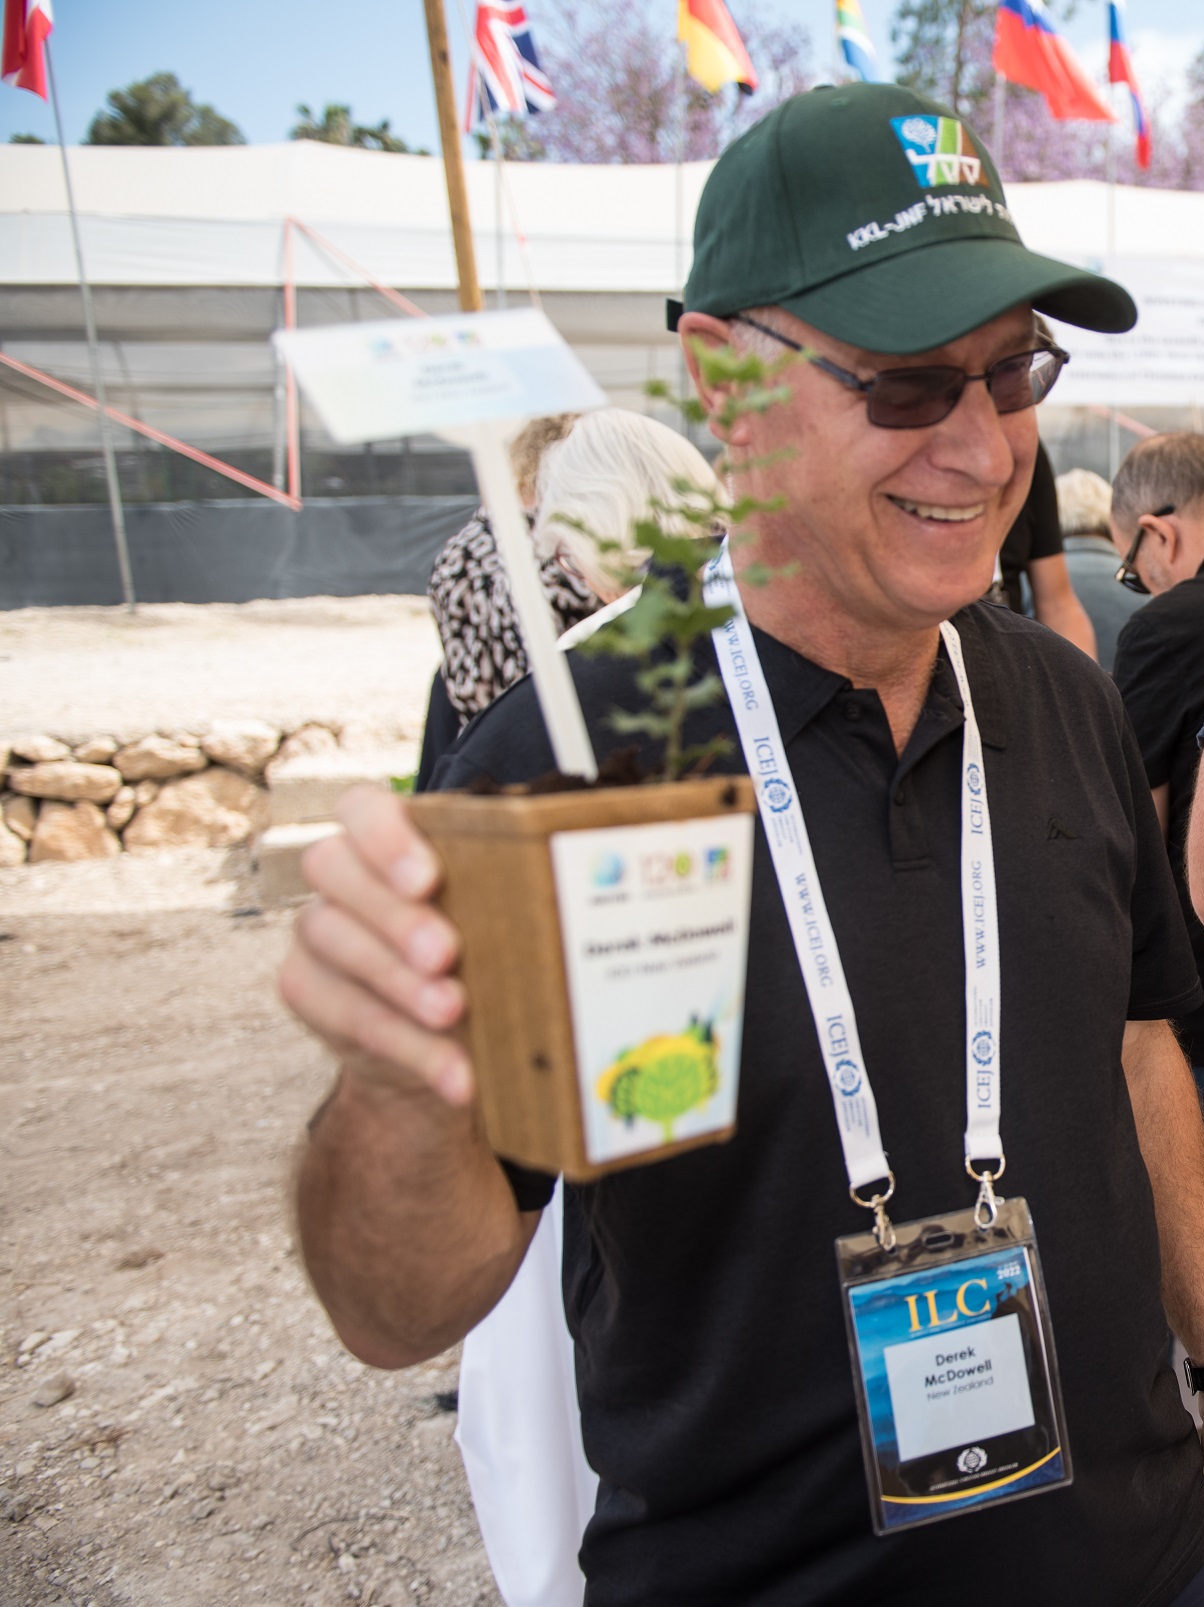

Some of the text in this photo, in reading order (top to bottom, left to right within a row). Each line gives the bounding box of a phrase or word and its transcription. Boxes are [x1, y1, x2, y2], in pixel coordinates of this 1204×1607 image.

[846, 202, 927, 250] KKL-JNF
[724, 618, 758, 711] WW.ICEJ.ORG
[753, 736, 779, 777] ICEJ
[971, 798, 985, 835] ICEJ
[795, 872, 834, 988] WWW.ICEJ.ORG
[976, 860, 986, 970] WWW.ICEJ.ORG
[827, 1014, 849, 1058] ICEJ
[977, 1069, 994, 1110] ICEJ
[997, 1264, 1021, 1280] 2022
[904, 1278, 991, 1332] ILC
[925, 1359, 992, 1388] McDowell
[935, 1346, 976, 1367] Derek
[927, 1376, 994, 1402] New Zealand
